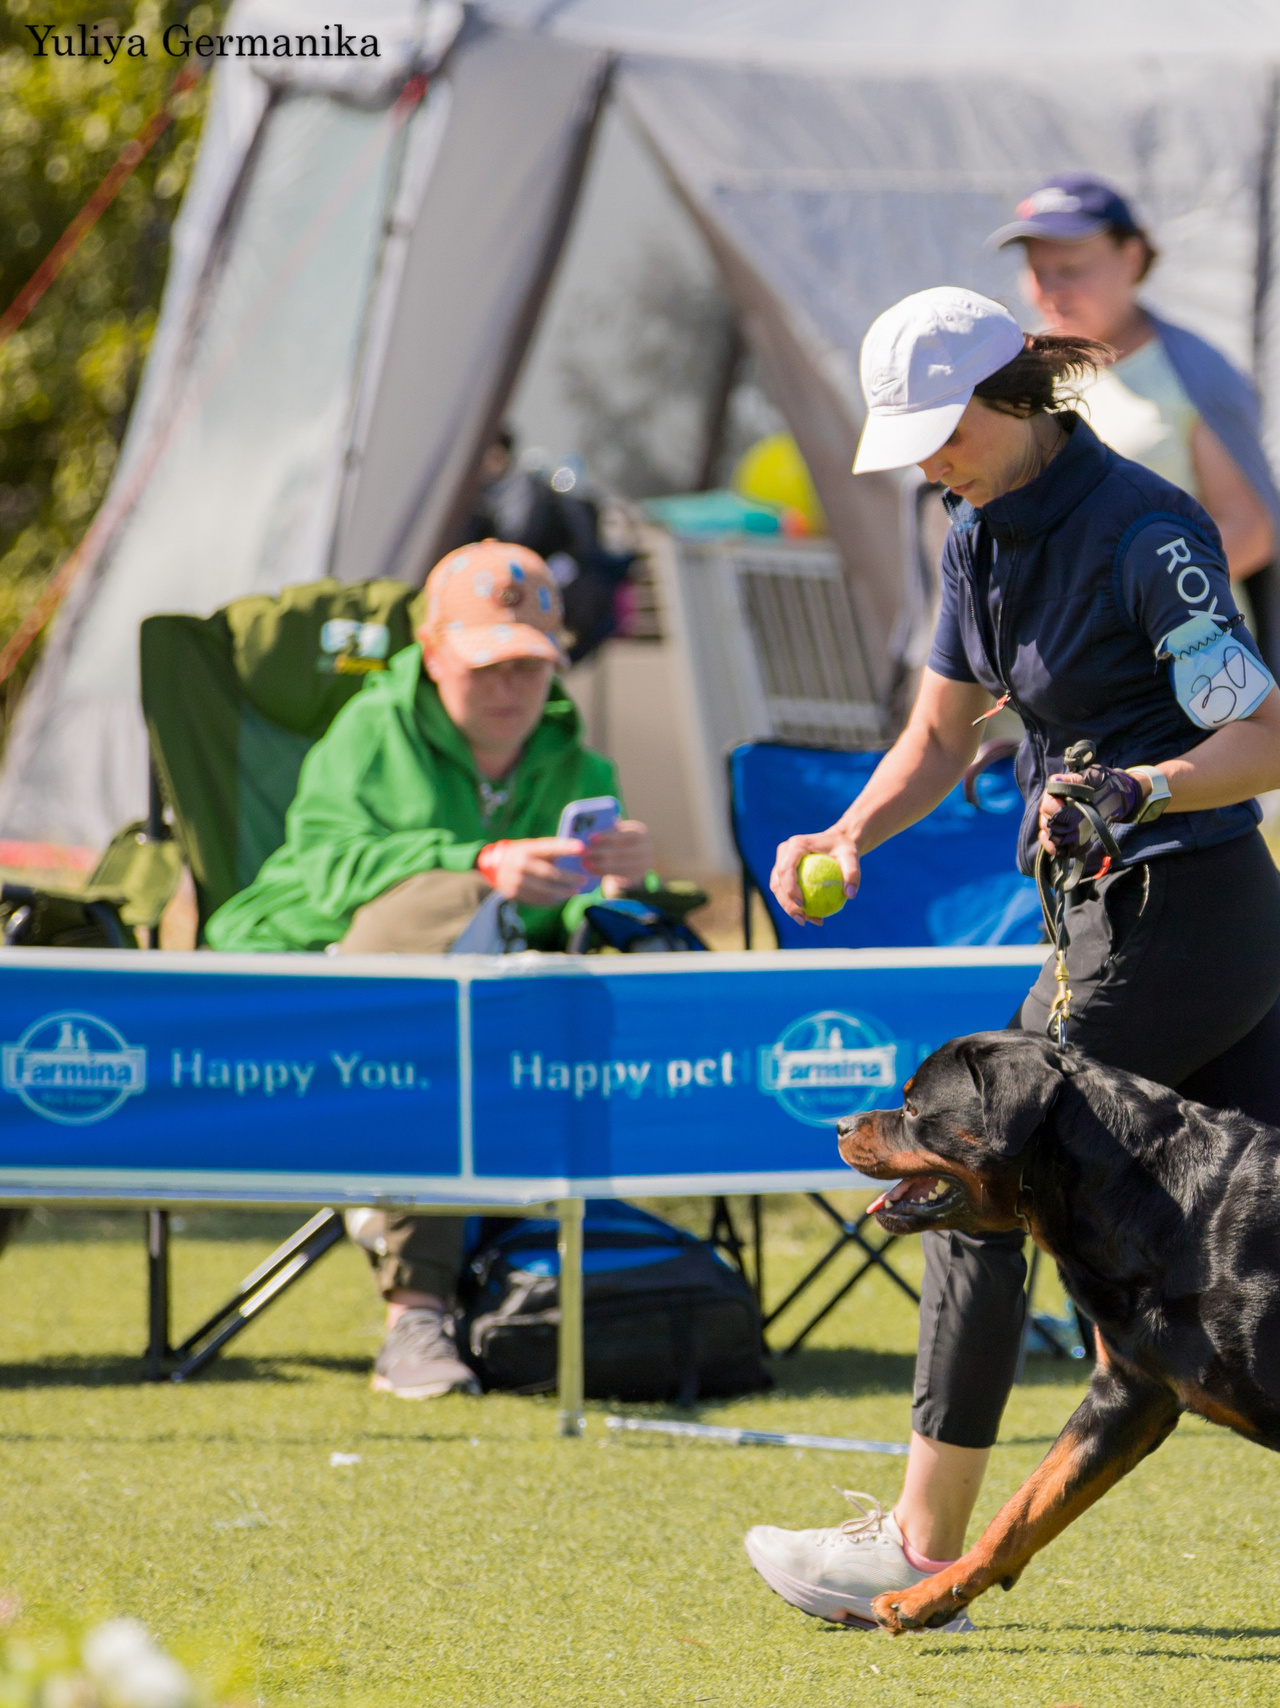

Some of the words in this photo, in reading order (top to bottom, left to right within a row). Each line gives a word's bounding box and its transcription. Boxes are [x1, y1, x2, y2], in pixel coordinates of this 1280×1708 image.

[1191, 646, 1246, 724] 30
[15, 1055, 132, 1083] Farmina
[170, 1048, 314, 1097] Happy
[331, 1050, 431, 1090] You.
[510, 1048, 651, 1098] Happy
